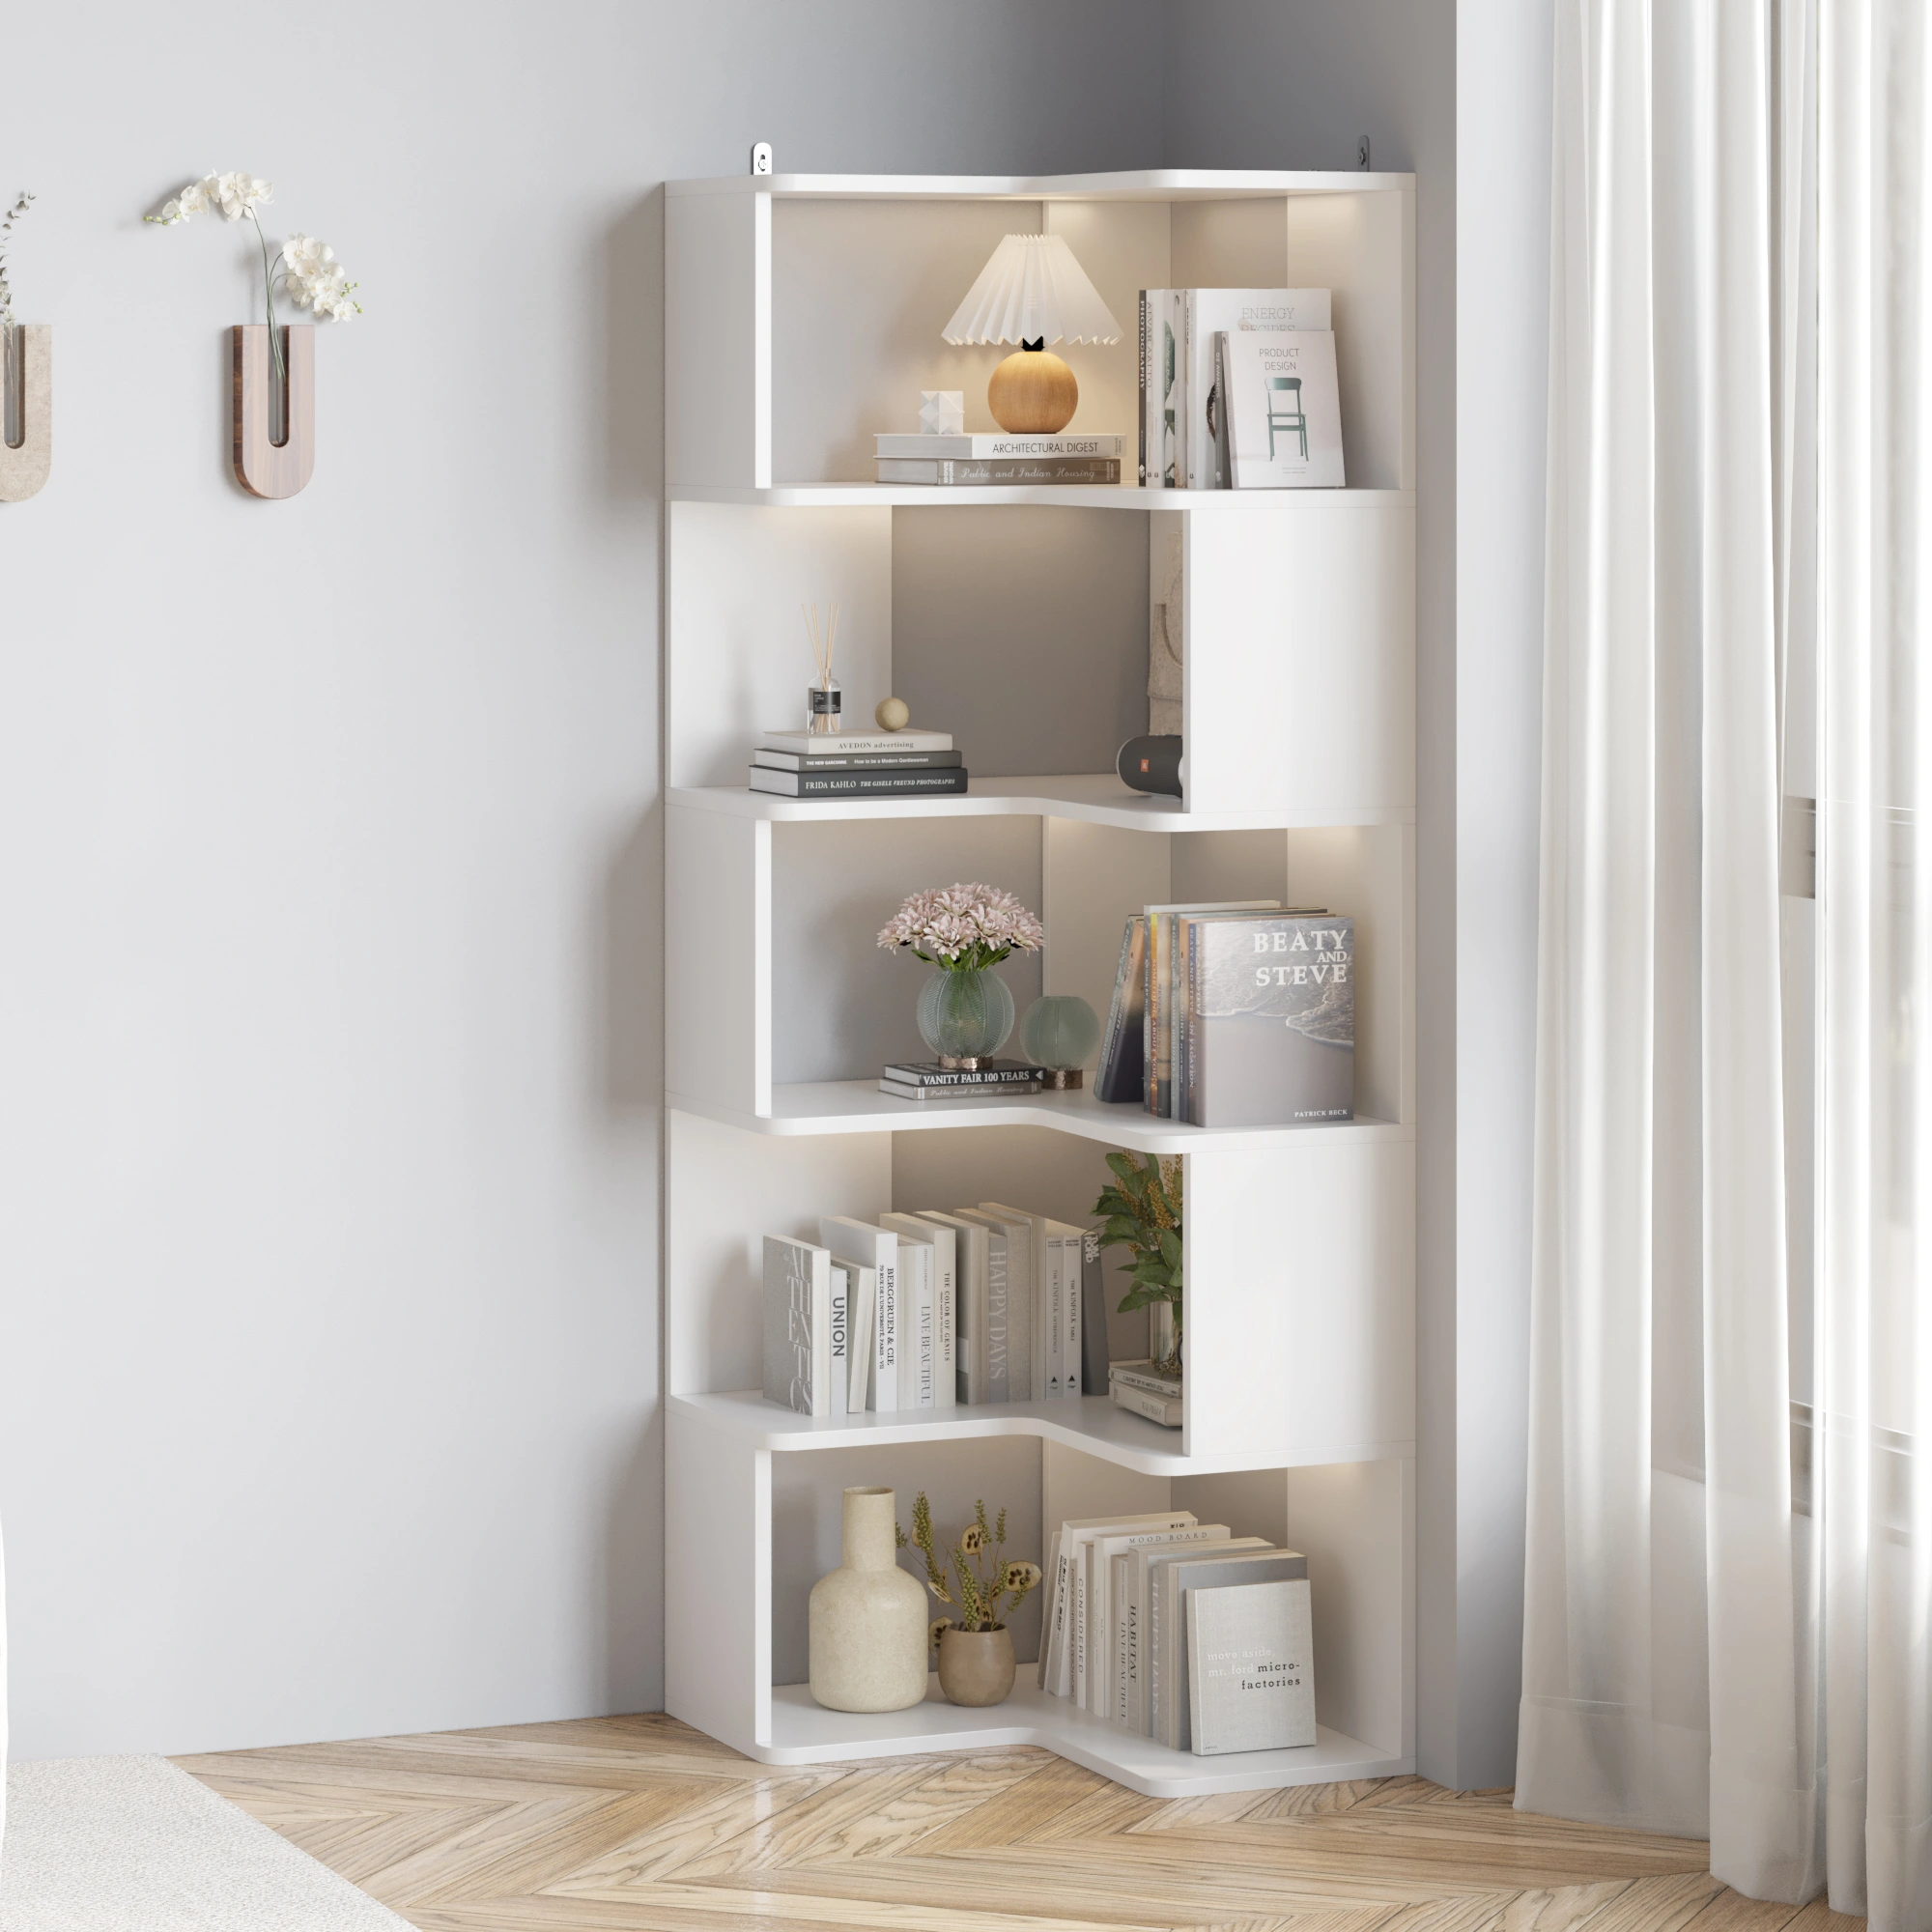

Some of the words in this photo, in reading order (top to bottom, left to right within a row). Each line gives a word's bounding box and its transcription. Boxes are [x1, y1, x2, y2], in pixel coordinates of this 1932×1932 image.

[1241, 307, 1295, 320] ENERGY
[1259, 348, 1300, 357] PRODUCT
[1264, 361, 1296, 371] DESIGN
[992, 442, 1065, 454] ARCHITECTURAL
[1066, 441, 1099, 453] DIGEST
[961, 468, 991, 479] Public
[995, 468, 1015, 478] and
[1017, 467, 1052, 478] Indian
[1055, 468, 1096, 482] Housing
[806, 781, 828, 789] FRIDA
[830, 781, 857, 789] KAHLO
[1253, 929, 1347, 953] BEATY
[1316, 951, 1348, 963] AND
[1256, 963, 1347, 986] STEVE
[1116, 998, 1126, 1030] NIGHTS
[923, 1074, 960, 1085] VANITY
[961, 1073, 982, 1084] FAIR
[983, 1072, 999, 1082] 100
[1000, 1071, 1030, 1081] YEARS
[1084, 1236, 1094, 1263] FORD
[989, 1251, 1007, 1321] HAPPY
[921, 1305, 931, 1333] LIVE
[944, 1320, 951, 1329] OF
[833, 1296, 845, 1357] UNION
[887, 1336, 895, 1345] &
[989, 1326, 1007, 1379] DAYS
[921, 1336, 931, 1404] BEAUTIFUL
[1129, 1535, 1161, 1545] MOOD
[1169, 1532, 1208, 1541] BOARD
[1208, 1652, 1237, 1661] move
[1242, 1647, 1275, 1659] aside,
[1231, 1663, 1254, 1675] ford
[1258, 1662, 1300, 1672] micro-
[1241, 1676, 1300, 1690] factories
